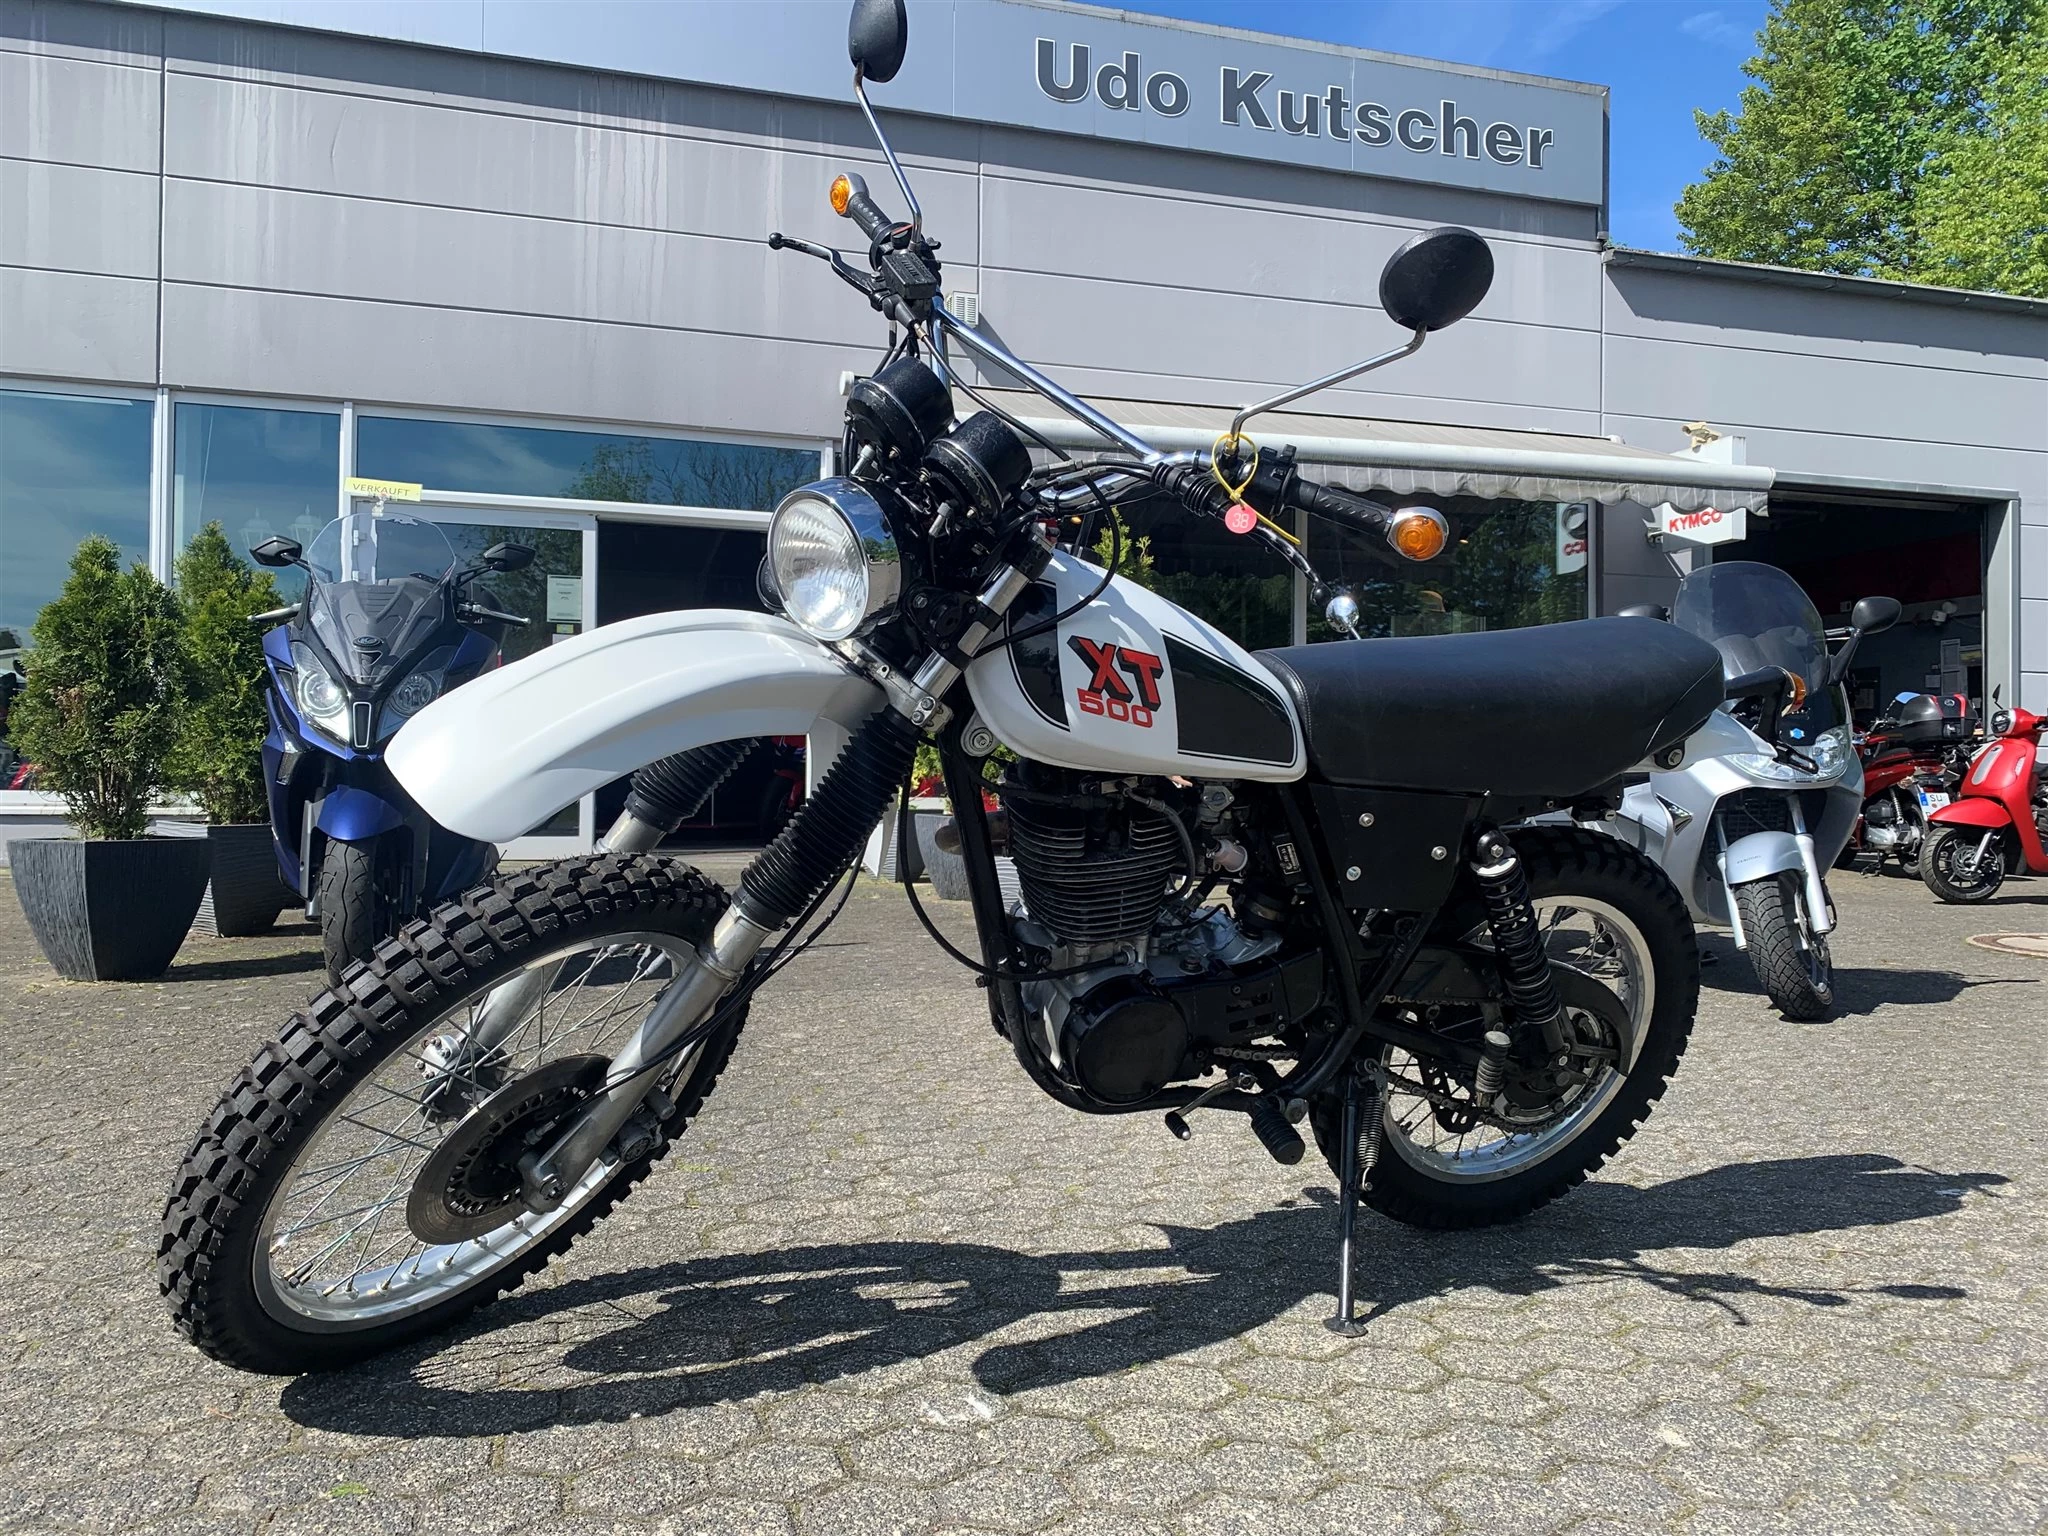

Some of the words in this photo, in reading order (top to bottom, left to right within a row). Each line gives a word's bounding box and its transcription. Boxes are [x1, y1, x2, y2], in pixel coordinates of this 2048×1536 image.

[1034, 37, 1191, 118] Udo
[1219, 66, 1555, 169] Kutscher
[352, 483, 411, 497] VERKAUFT
[1232, 512, 1250, 528] 38
[1668, 508, 1723, 533] KYMCO
[1066, 635, 1164, 712] XT
[1076, 687, 1153, 728] 500
[1929, 793, 1943, 802] SU
